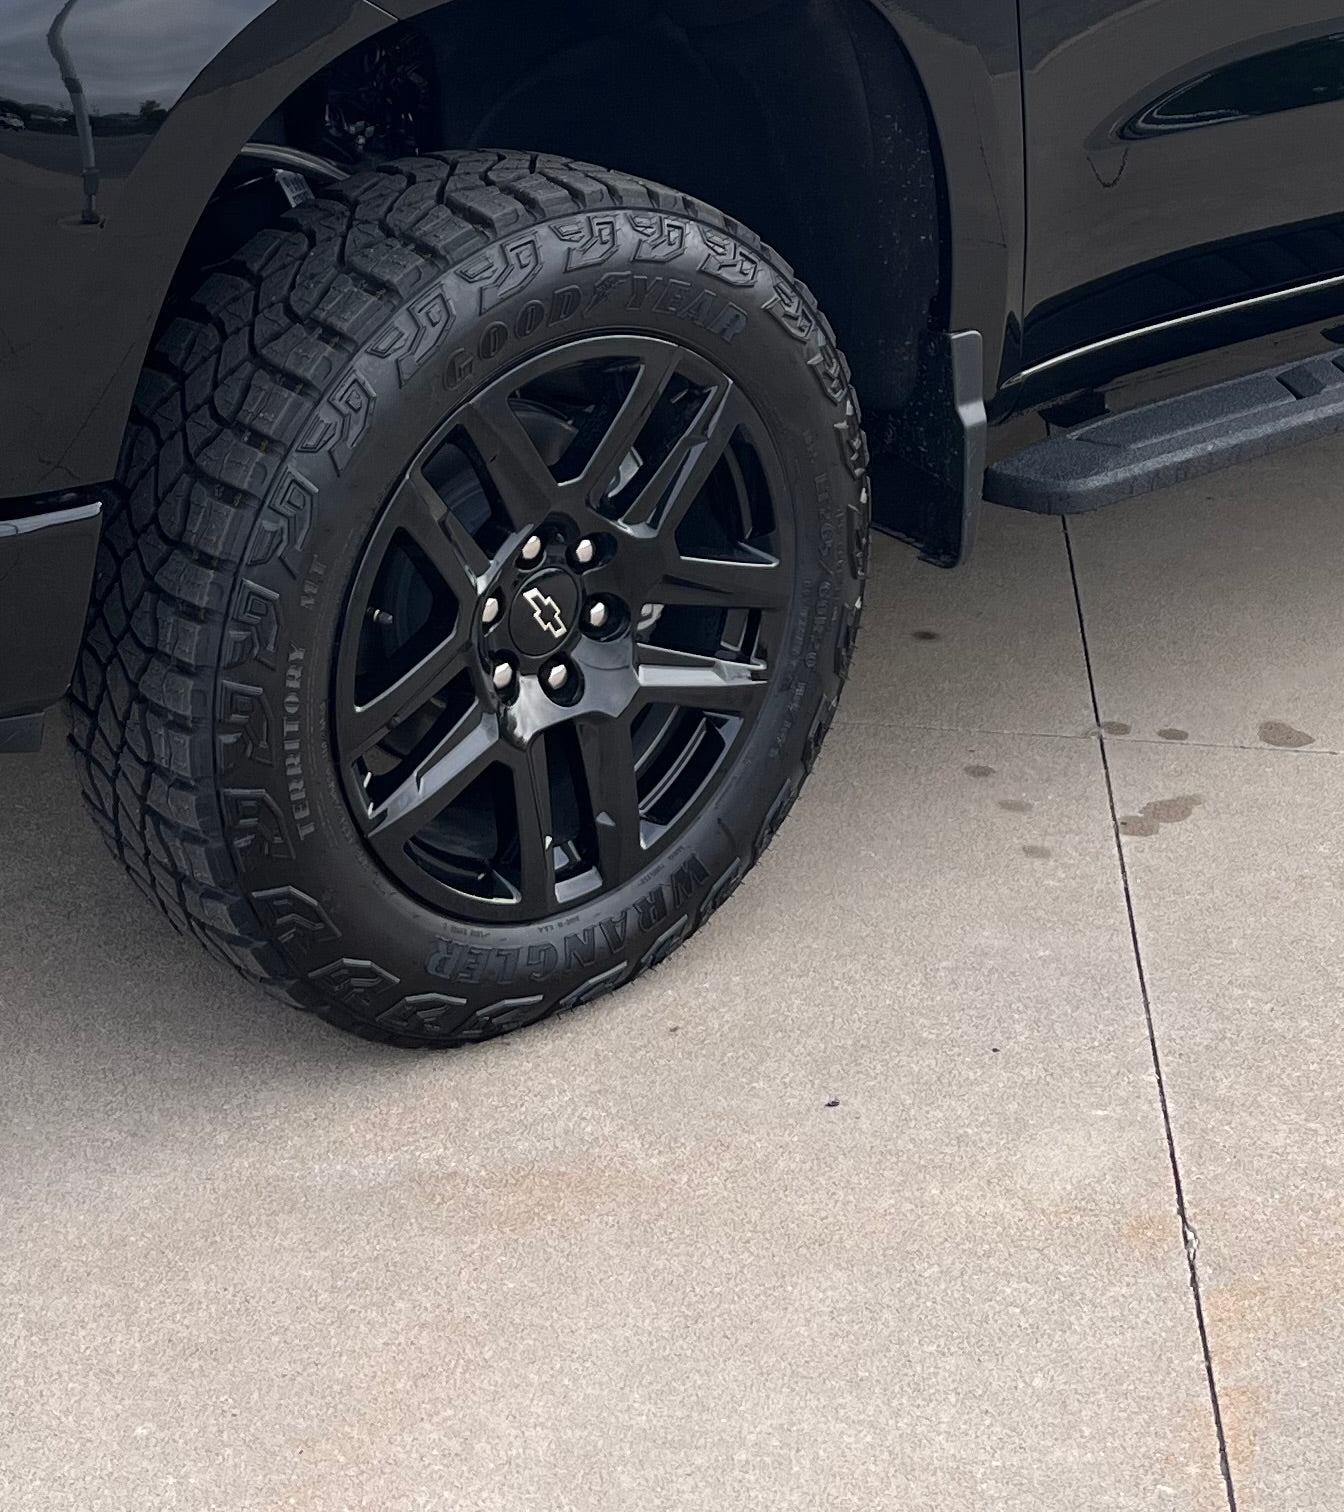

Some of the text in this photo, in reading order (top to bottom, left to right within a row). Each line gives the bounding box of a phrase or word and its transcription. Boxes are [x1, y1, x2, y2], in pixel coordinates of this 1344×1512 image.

[443, 271, 748, 391] GOODYEAR
[283, 641, 316, 841] TERRITORY
[424, 852, 711, 984] WRANGLER
